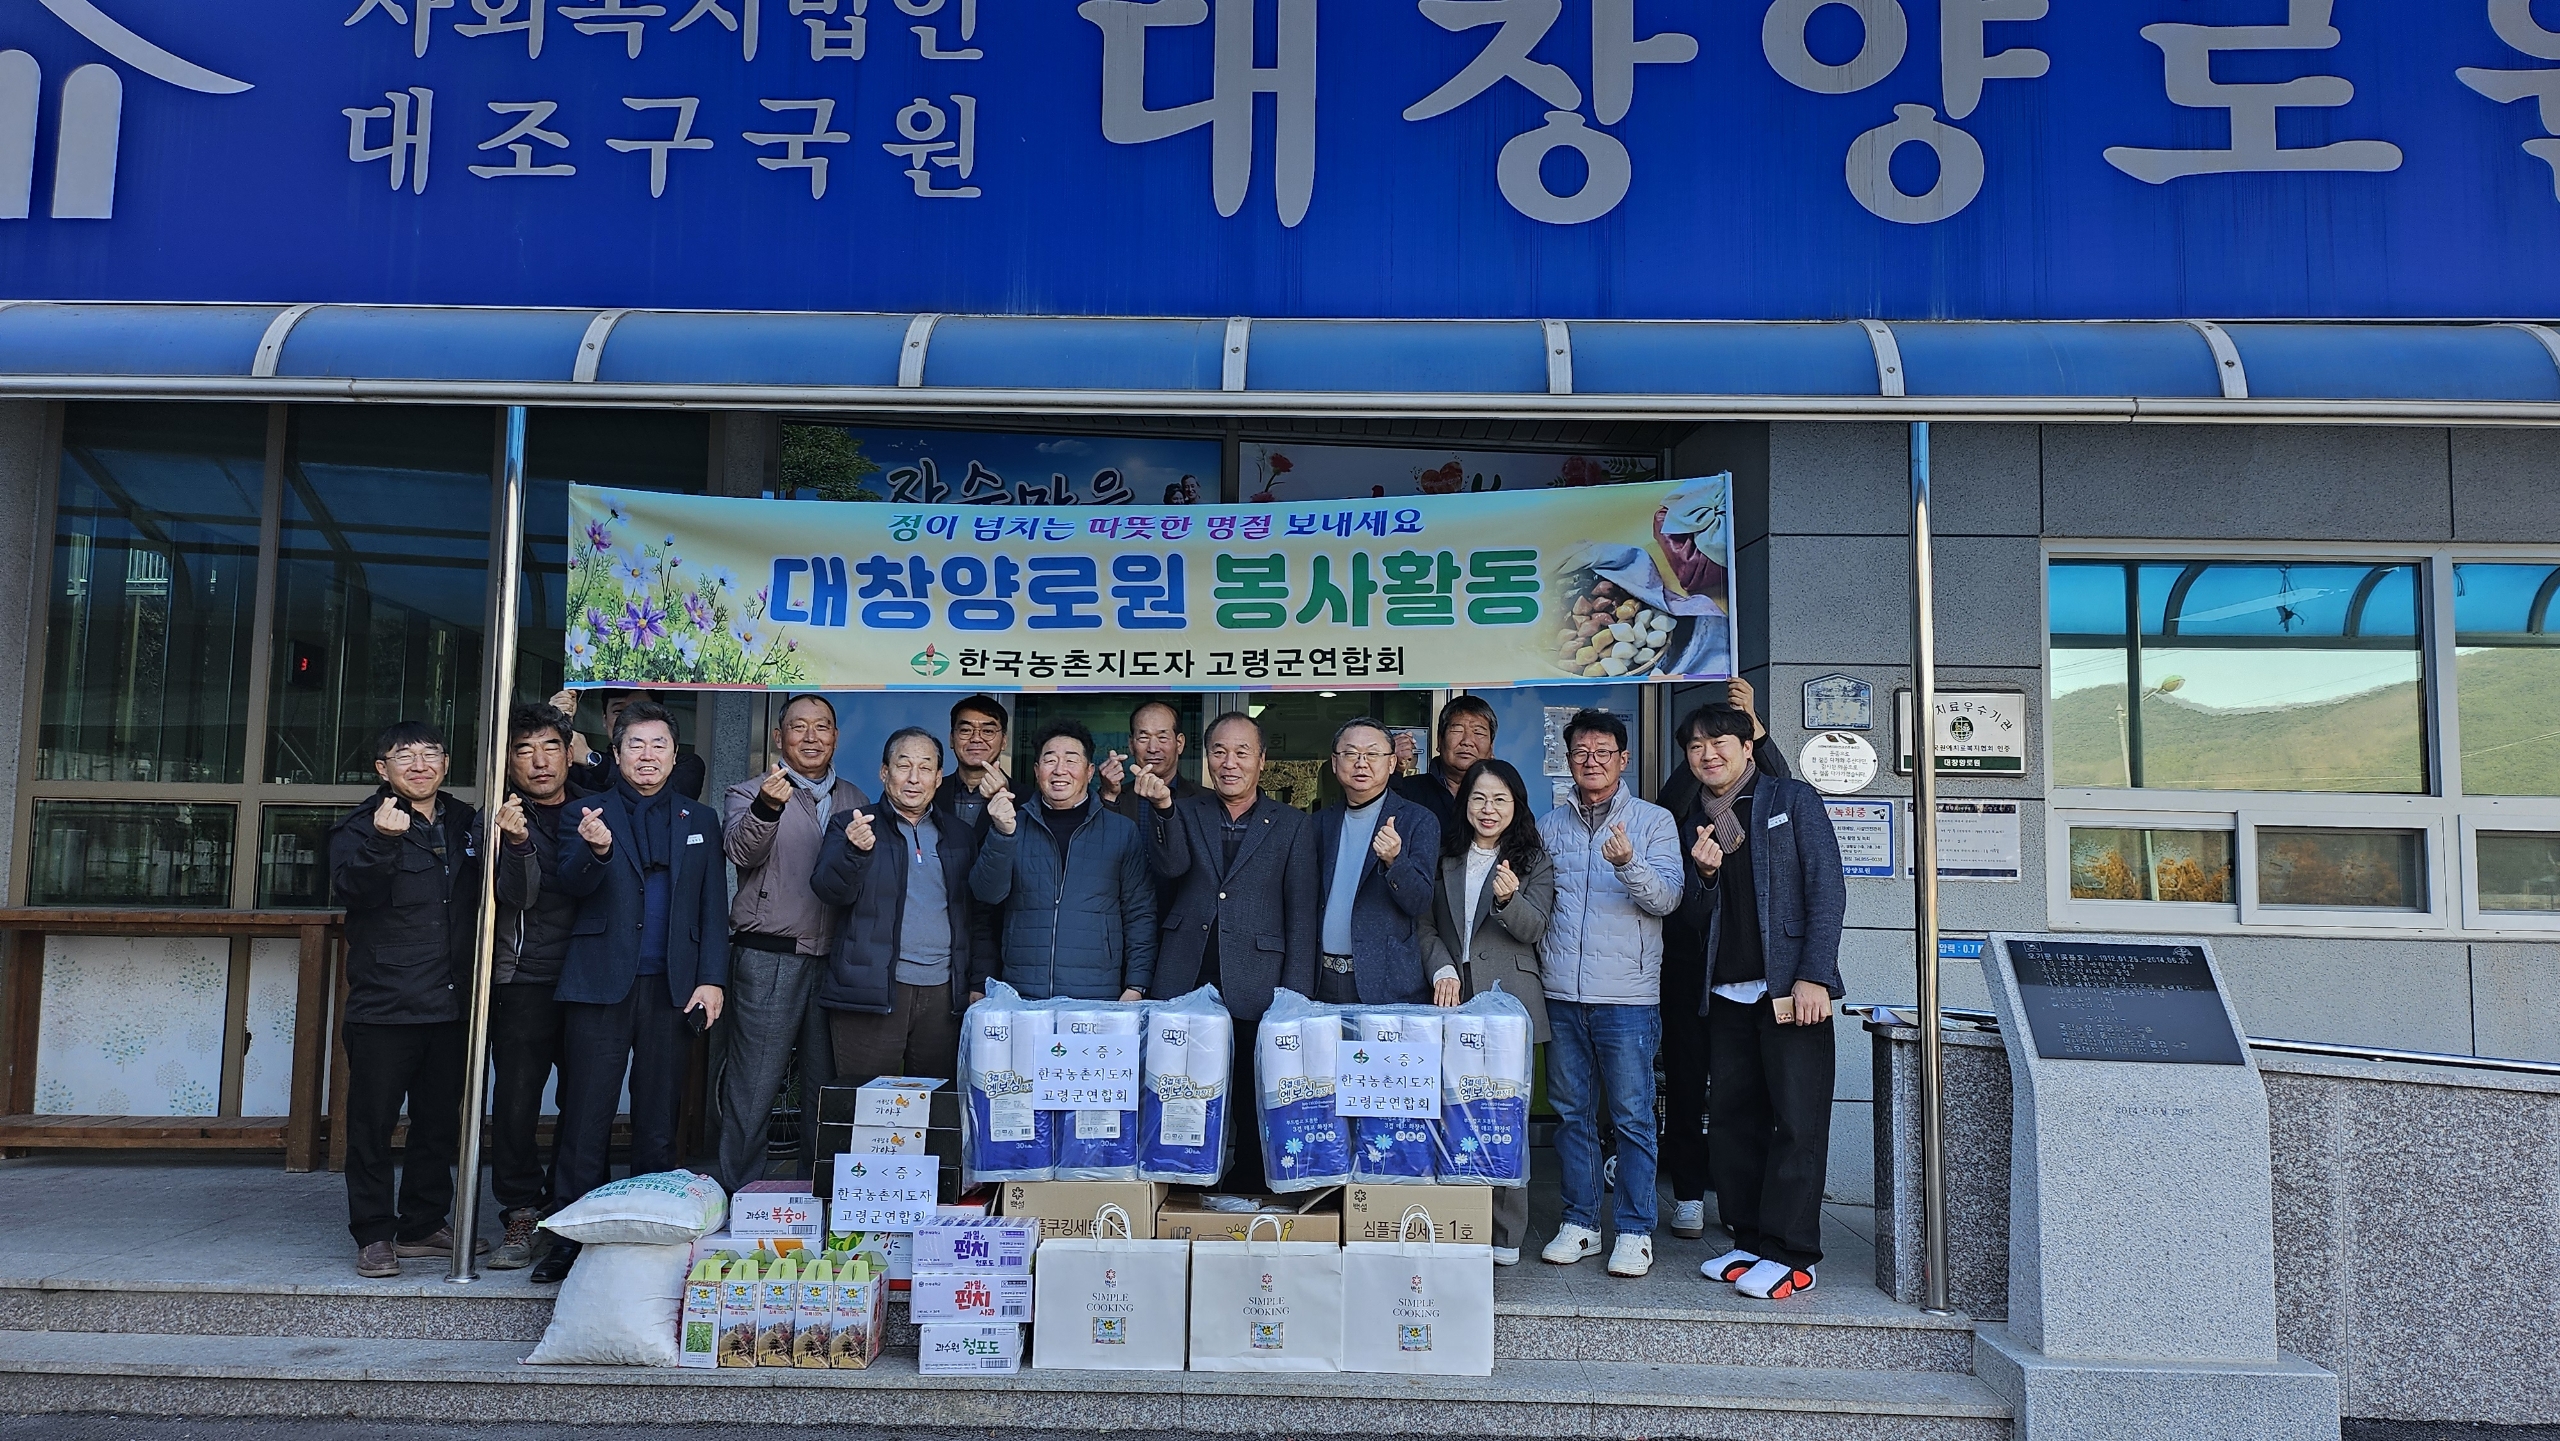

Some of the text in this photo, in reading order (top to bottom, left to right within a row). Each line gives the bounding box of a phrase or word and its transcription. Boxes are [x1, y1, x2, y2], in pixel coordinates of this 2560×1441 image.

[342, 86, 983, 199] 대조구국원
[888, 507, 1426, 541] 정이 넘치는 따뜻한 명절 보내세요
[768, 549, 1543, 631] 대창양로원 봉사활동
[958, 645, 1405, 678] 한국농촌지도자 고령군연합회
[1962, 944, 1976, 954] 0.7
[1037, 1066, 1134, 1082] 한국농촌지도자
[1340, 1074, 1436, 1091] 한국농촌지도자
[1041, 1089, 1129, 1104] 고령군연합회
[1344, 1096, 1431, 1111] 고령군연합회
[837, 1187, 932, 1203] 한국농촌지도자
[771, 1206, 808, 1224] 복숭아
[839, 1209, 926, 1224] 고령군연합회
[963, 1230, 980, 1240] 과일
[1363, 1220, 1445, 1240] 심플쿠킹세트
[953, 1239, 990, 1260] 펀치
[963, 1280, 981, 1290] 과일
[954, 1289, 991, 1310] 펀치
[1092, 1292, 1129, 1302] SIMPLE
[1248, 1296, 1285, 1306] SIMPLE
[1398, 1297, 1435, 1307] SIMPLE
[1086, 1302, 1134, 1313] COOKING
[1242, 1306, 1290, 1316] COOKING
[1392, 1307, 1440, 1318] COOKING
[962, 1337, 1001, 1356] 청포도
